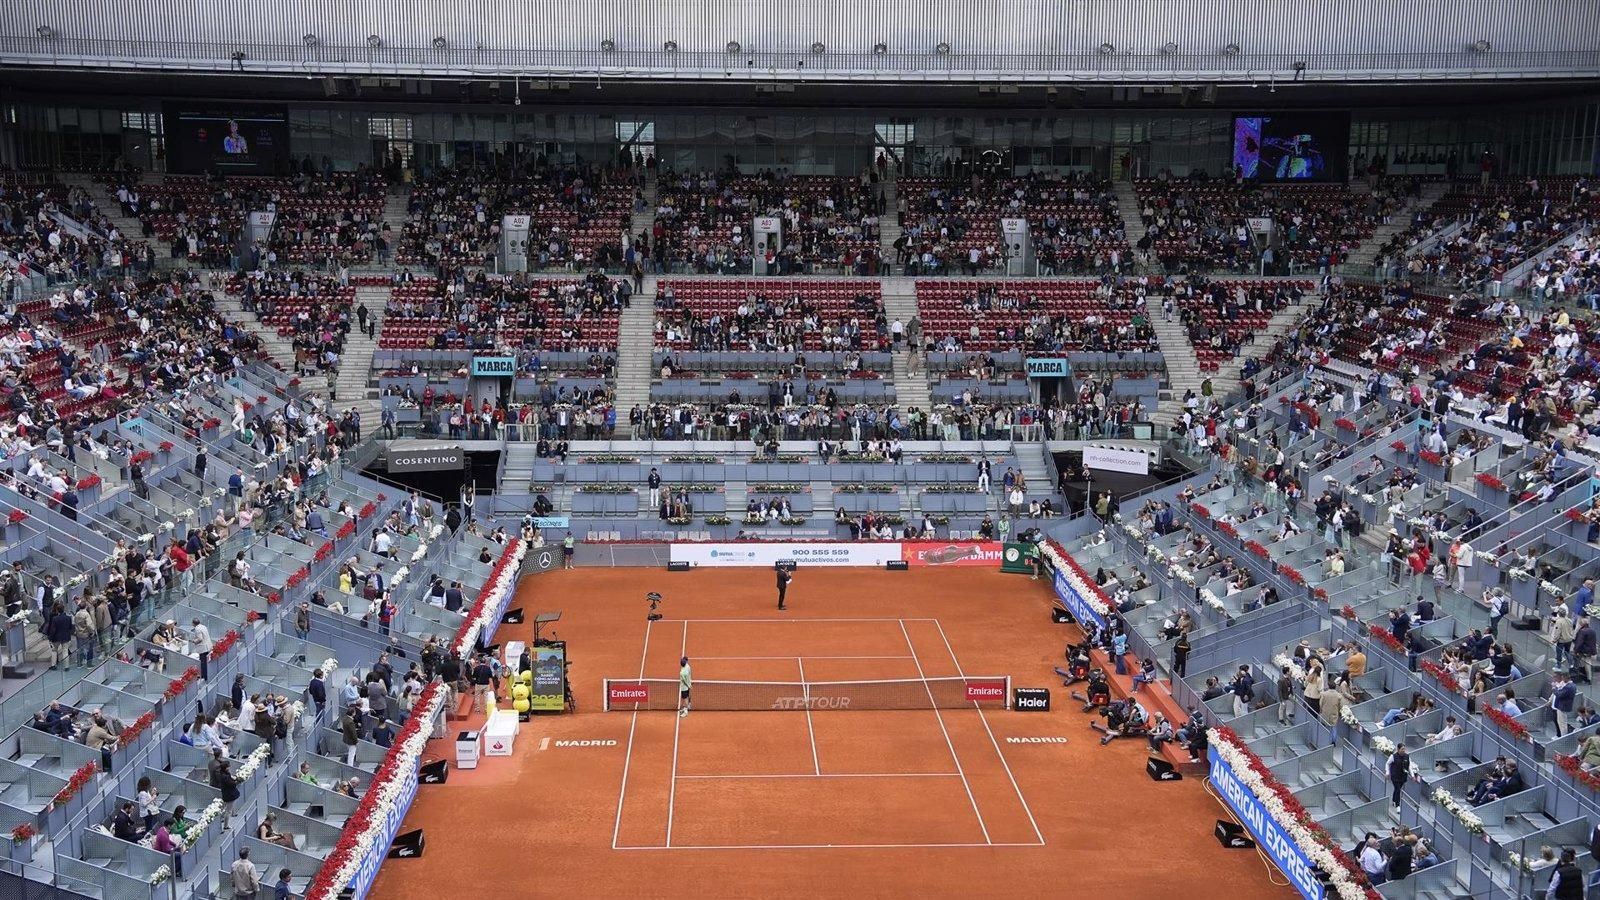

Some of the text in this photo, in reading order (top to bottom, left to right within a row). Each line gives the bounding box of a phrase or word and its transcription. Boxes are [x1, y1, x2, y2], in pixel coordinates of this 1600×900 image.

[477, 361, 513, 372] MARCA
[1028, 362, 1062, 373] MARCA
[395, 456, 457, 465] COSENTINO
[1090, 455, 1141, 466] nh-collection.com
[611, 689, 646, 698] Emirates
[968, 687, 1003, 695] Emirates
[771, 696, 851, 709] ATP TOUR
[1018, 697, 1047, 707] Haier
[1212, 760, 1319, 900] AMERICAN EXPRESS
